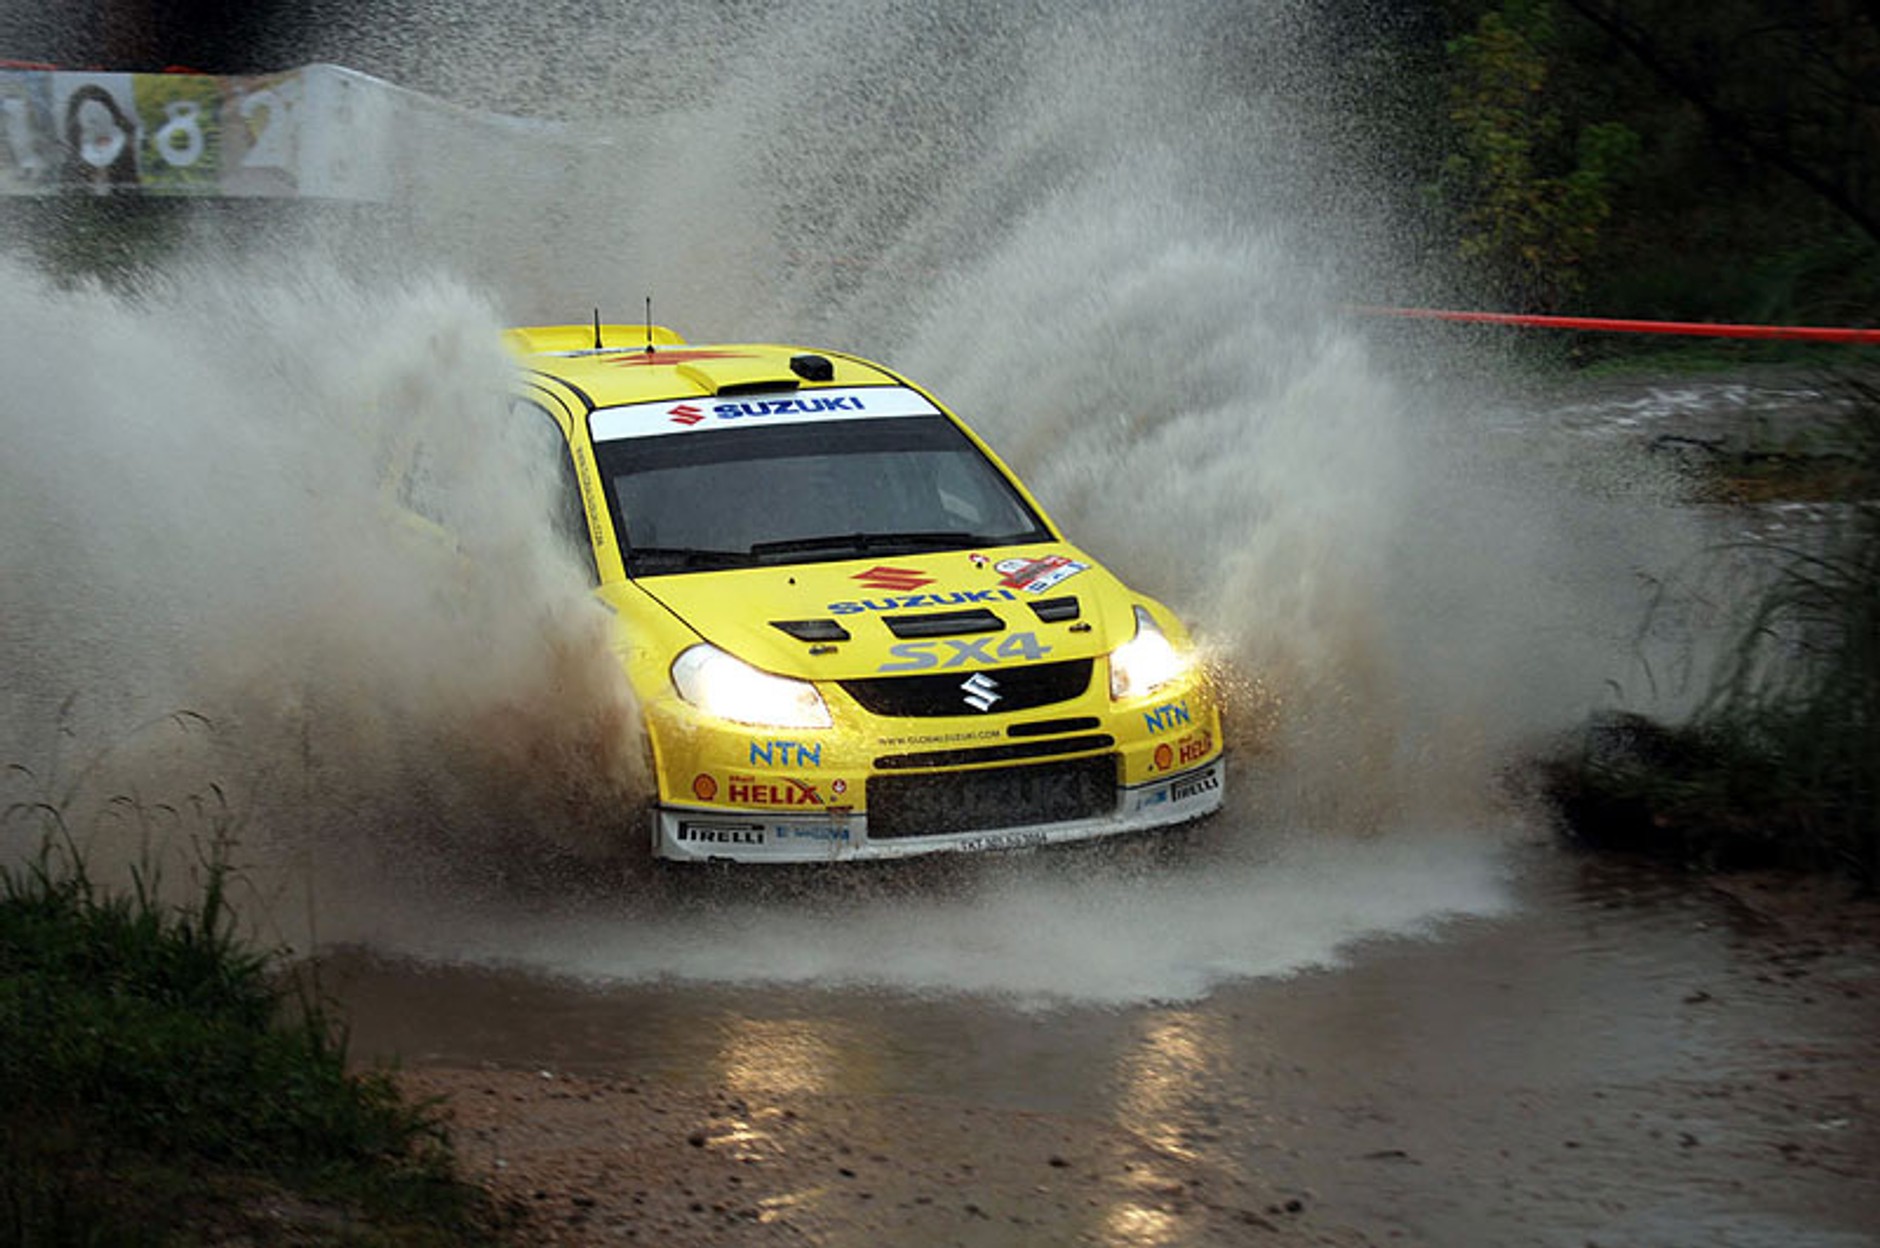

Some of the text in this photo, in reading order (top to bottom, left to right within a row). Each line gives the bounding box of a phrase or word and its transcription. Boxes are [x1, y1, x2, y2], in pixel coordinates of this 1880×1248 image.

[713, 396, 866, 420] SUZUKI
[827, 589, 1017, 615] SUZUKI
[877, 631, 1053, 673] SX4
[1142, 700, 1191, 734] NTN
[749, 740, 821, 767] NTN
[729, 780, 822, 805] HELIX
[1170, 768, 1219, 803] PIRELLI
[677, 820, 765, 844] PIRELLI
